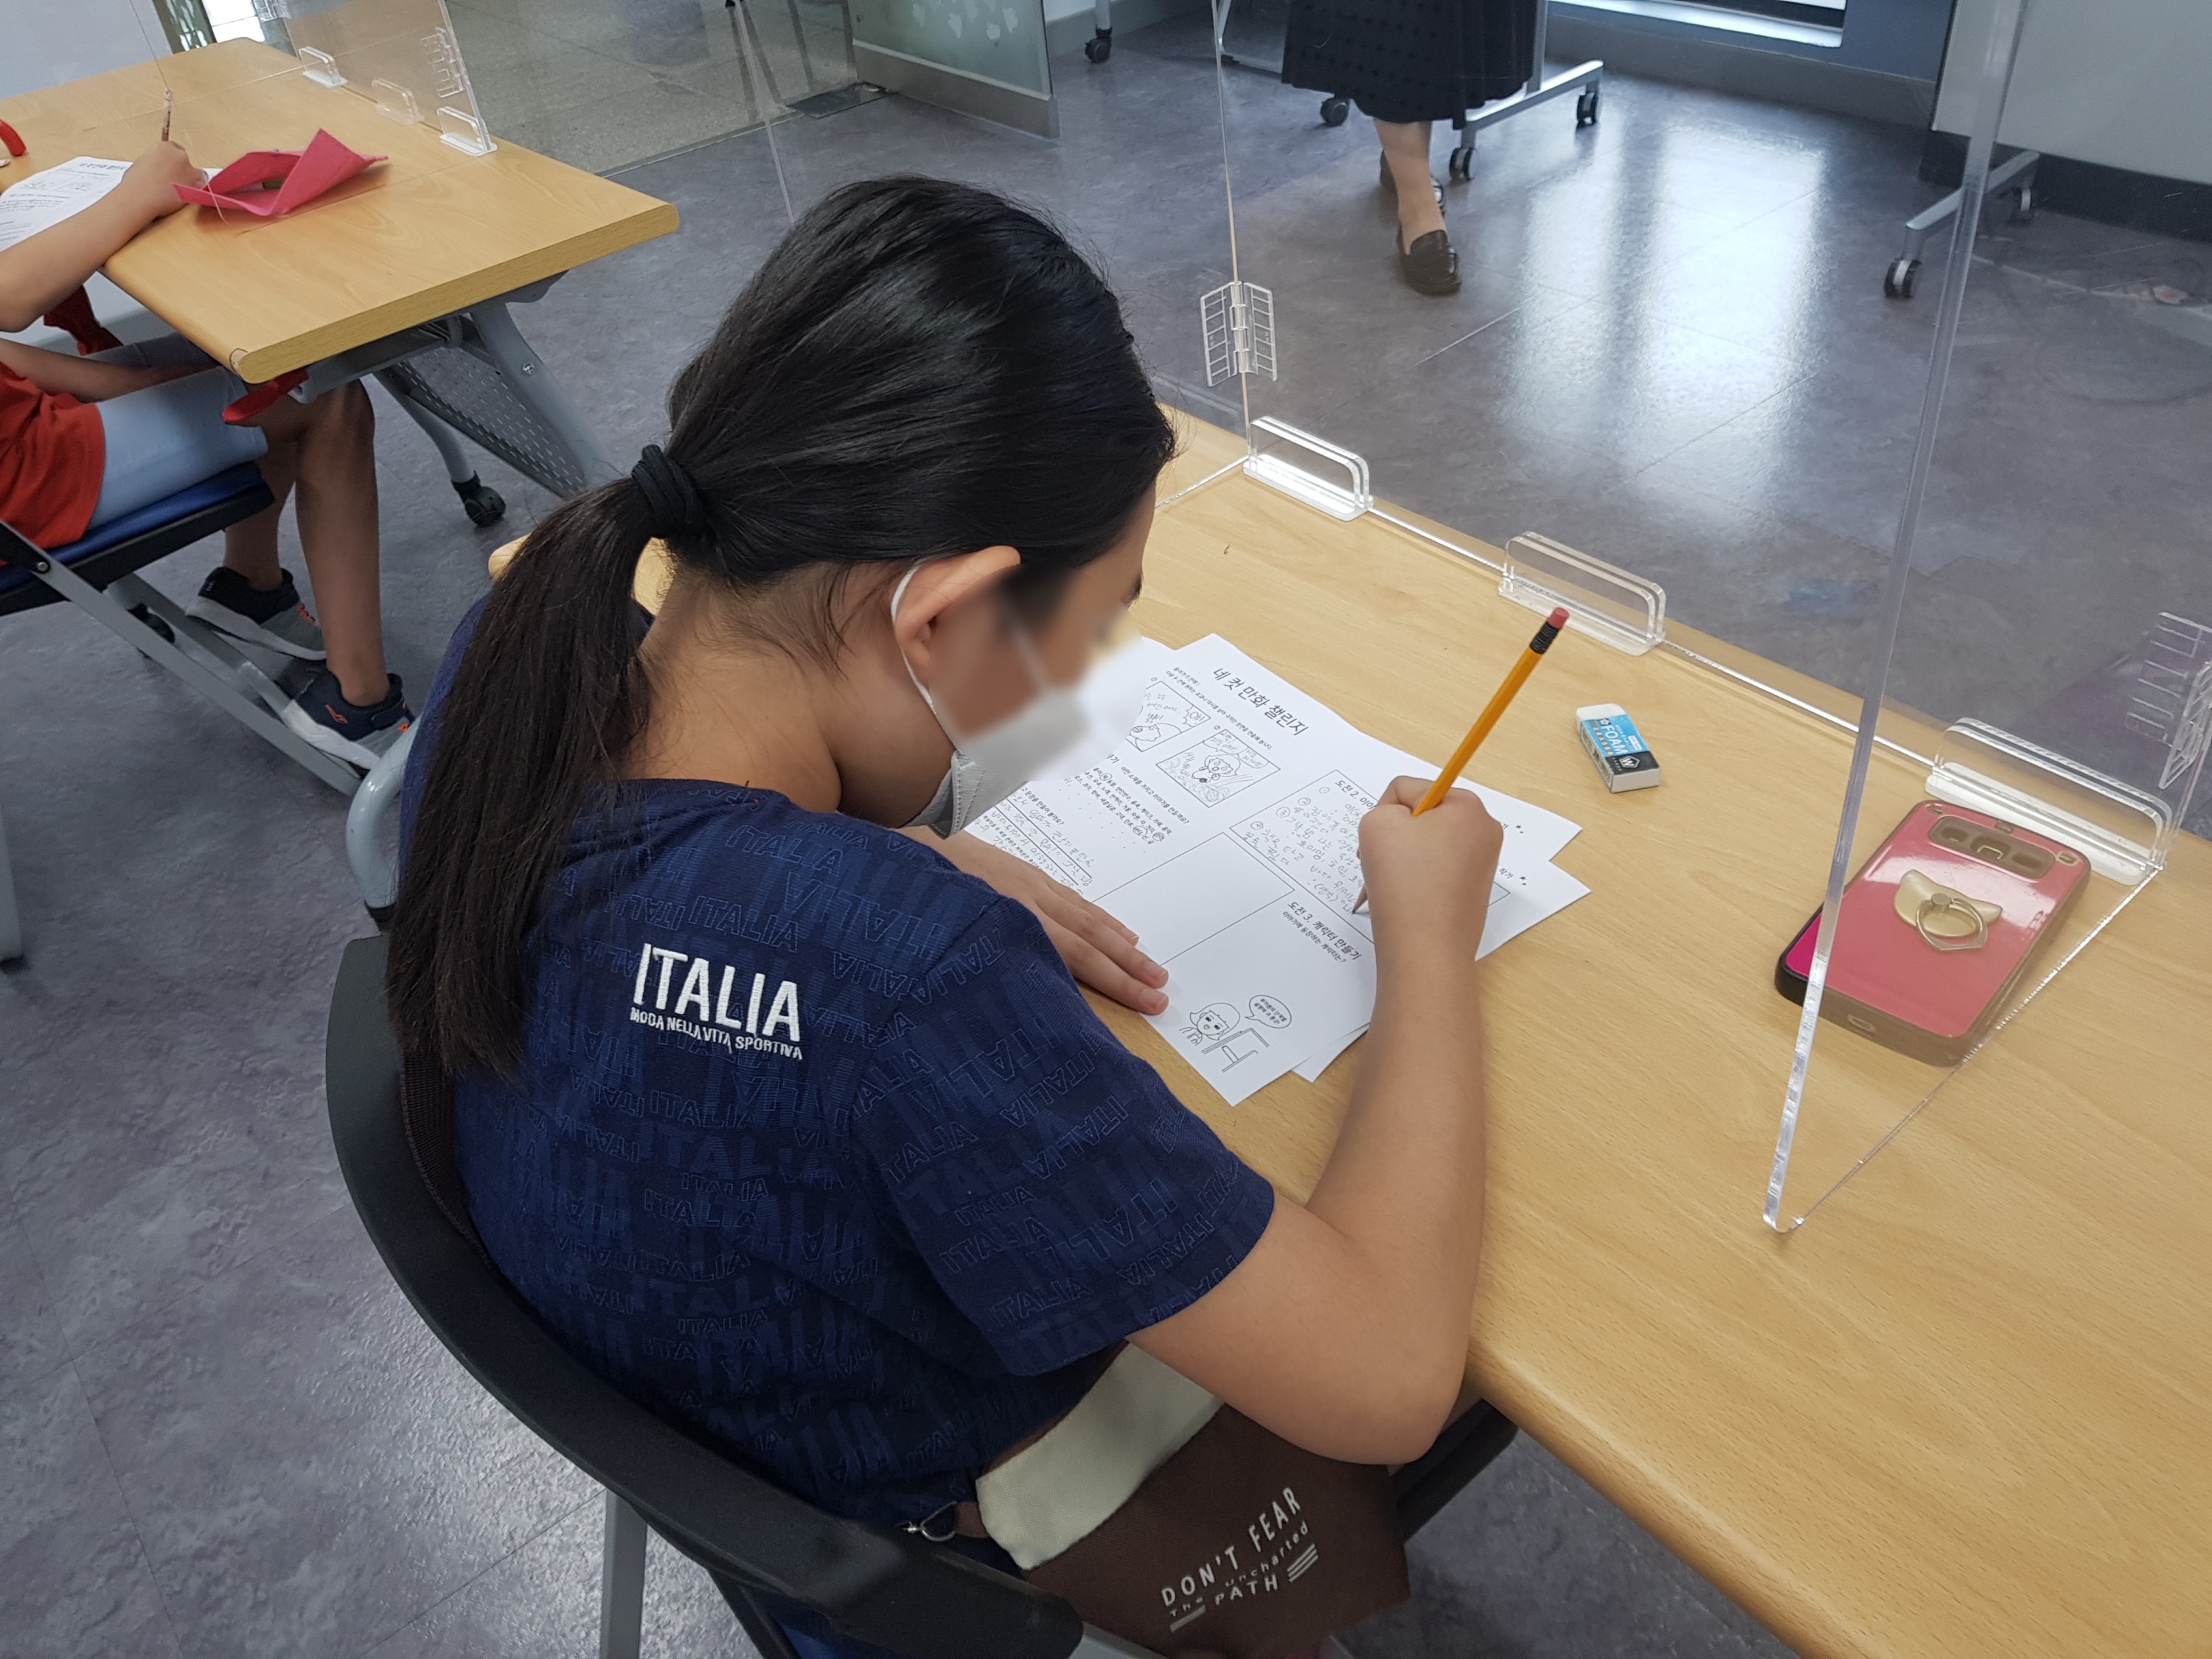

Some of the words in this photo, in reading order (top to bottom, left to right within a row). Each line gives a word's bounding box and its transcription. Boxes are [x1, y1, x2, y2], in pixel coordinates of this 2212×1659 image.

[1213, 668, 1231, 681] 네
[1223, 678, 1245, 690] 컷
[1238, 686, 1270, 708] 만화
[1264, 705, 1309, 736] 챌린지
[1601, 725, 1629, 754] FOAM
[1025, 791, 1039, 802] 문장을
[1036, 801, 1051, 813] 만들어
[1121, 767, 1130, 775] 어떤
[1128, 774, 1143, 785] 소재를
[1141, 784, 1155, 795] 가지고
[1153, 794, 1170, 808] 이야기를
[1168, 807, 1189, 824] 만들까요?
[1335, 780, 1353, 793] 도전
[728, 824, 844, 874] ITALIA
[689, 896, 801, 953] ITALIA
[1283, 911, 1304, 928] 이야기에
[1301, 927, 1321, 945] 등장하는
[1321, 943, 1346, 962] 캐릭터는?
[1287, 902, 1307, 916] 도전
[1303, 914, 1312, 923] 3.
[1312, 921, 1338, 941] 캐릭터
[1334, 939, 1362, 960] 만들기
[633, 943, 800, 1042] ITALIA
[630, 1007, 664, 1030] MODA
[700, 1027, 732, 1054] VITA
[735, 1037, 802, 1060] SPORTIVA
[1161, 1546, 1238, 1607] DON'T
[1248, 1487, 1301, 1552] FEAR
[1225, 1520, 1309, 1587] uncharted
[1215, 1573, 1278, 1605] PATH
